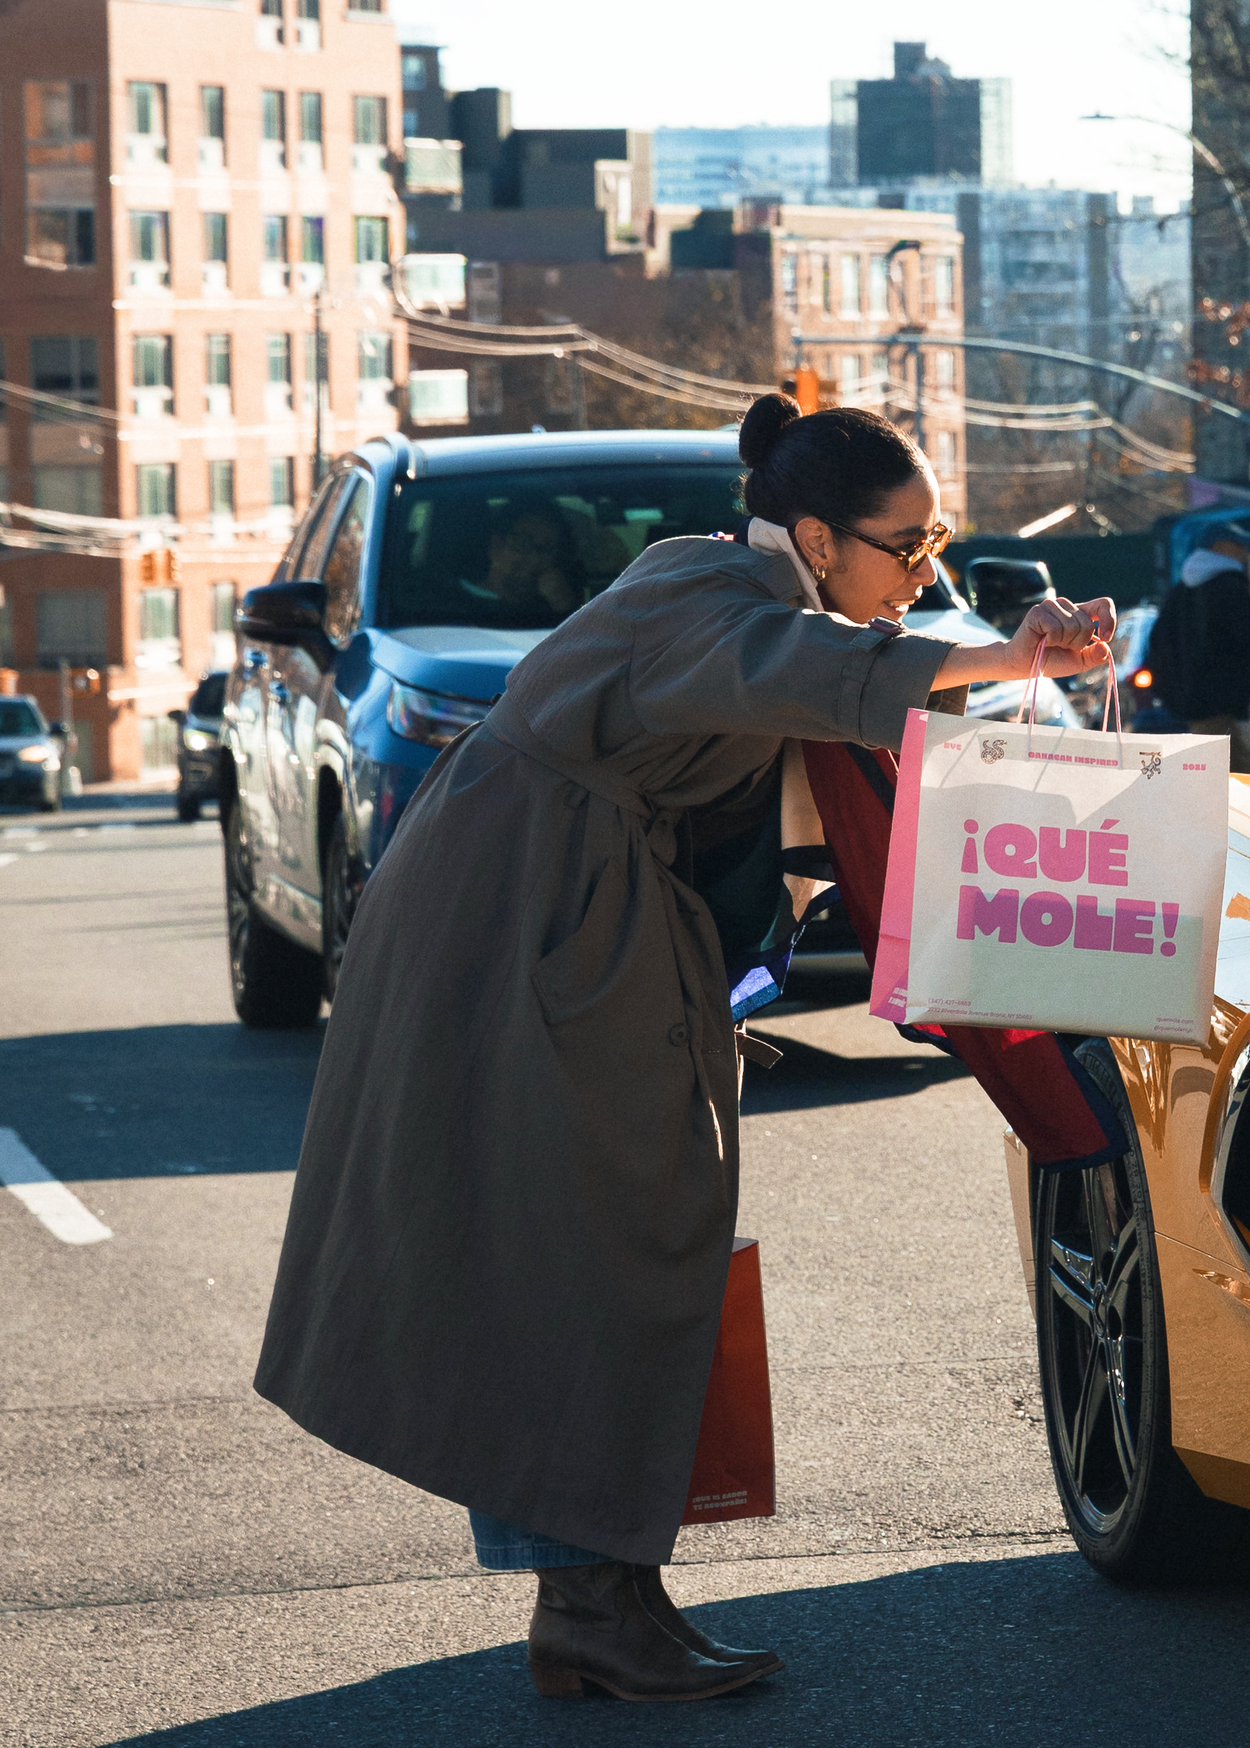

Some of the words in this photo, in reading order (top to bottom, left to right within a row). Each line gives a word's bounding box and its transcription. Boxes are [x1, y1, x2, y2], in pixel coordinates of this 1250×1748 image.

[1074, 756, 1119, 767] INSPIRED
[1182, 763, 1206, 771] 2025
[961, 818, 1129, 887] ¡QUÉ
[956, 884, 1180, 957] MOLE!
